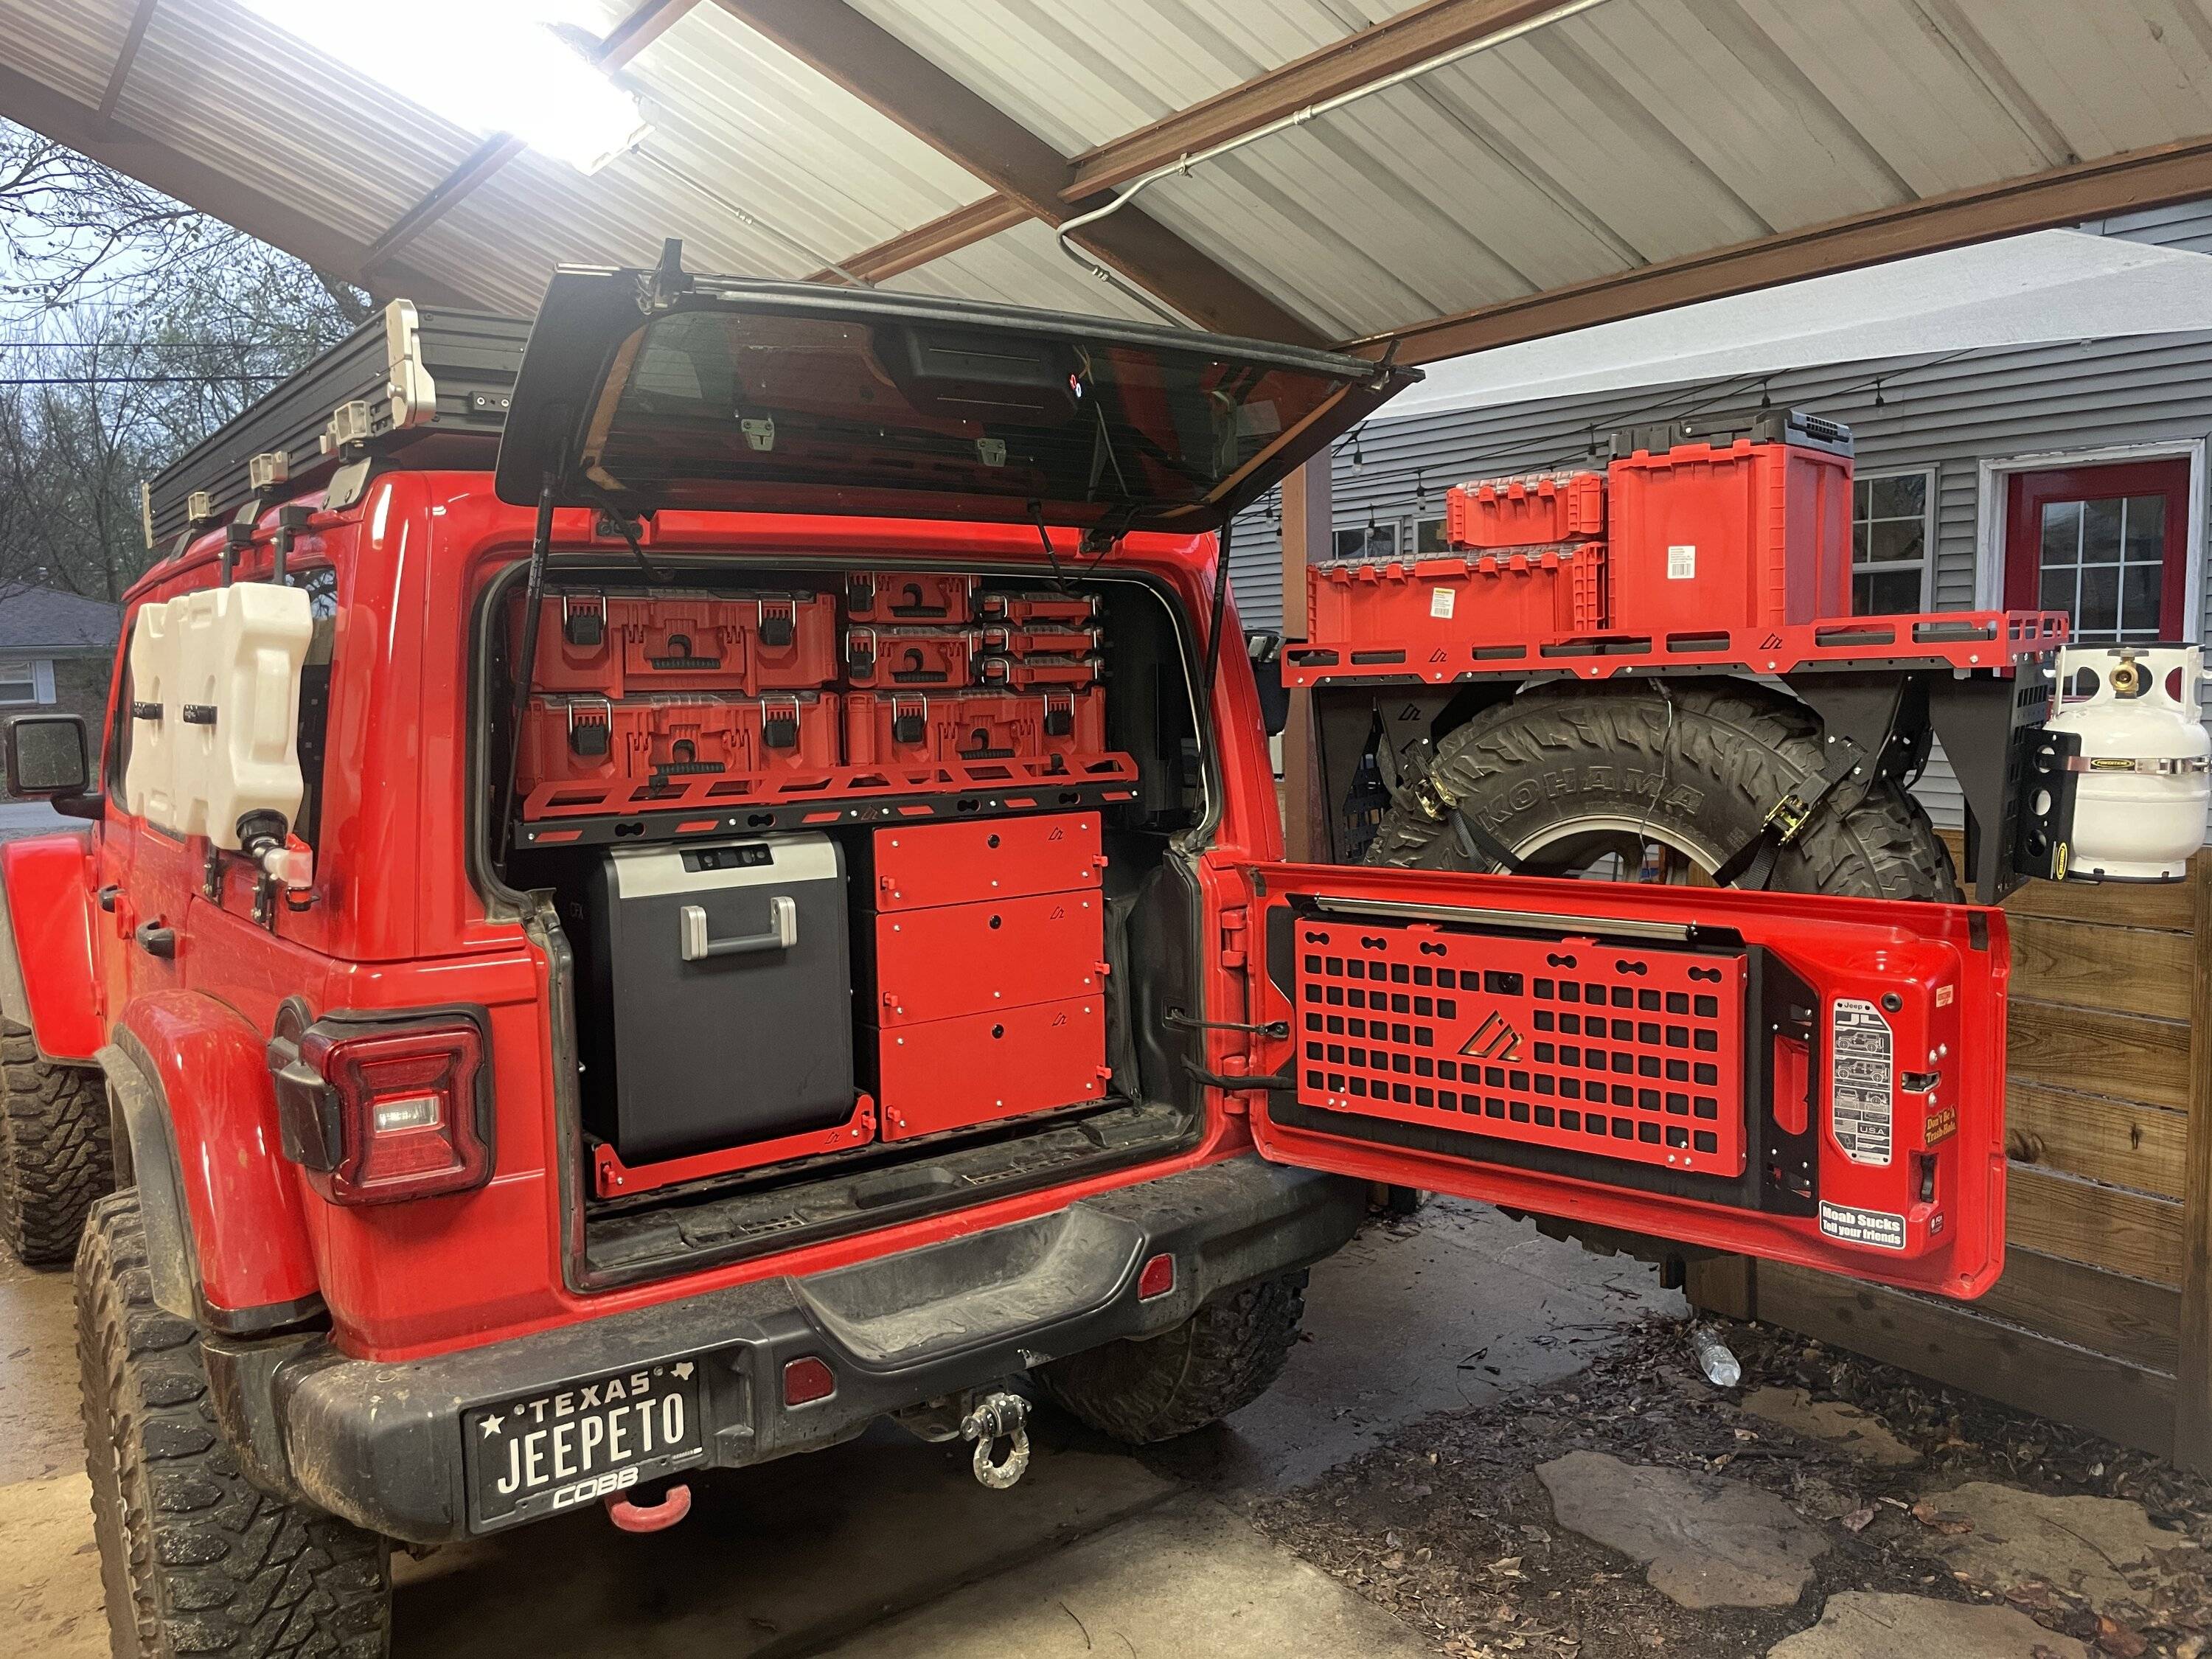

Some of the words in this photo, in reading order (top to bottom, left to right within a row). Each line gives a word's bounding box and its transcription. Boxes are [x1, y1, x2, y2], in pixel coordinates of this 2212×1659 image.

[1844, 1002, 1863, 1011] Jeep
[1837, 1014, 1883, 1026] JL
[1927, 1114, 1942, 1130] Don't
[1943, 1111, 1950, 1122] Be
[1823, 1206, 1855, 1224] Moab
[1857, 1214, 1900, 1231] Sucks
[1823, 1219, 1837, 1233] Tell
[1837, 1225, 1862, 1238] your
[1863, 1228, 1901, 1245] friends
[529, 1371, 650, 1423] TEXAS
[498, 1393, 684, 1494] JEEPETO
[553, 1467, 639, 1509] COBB
